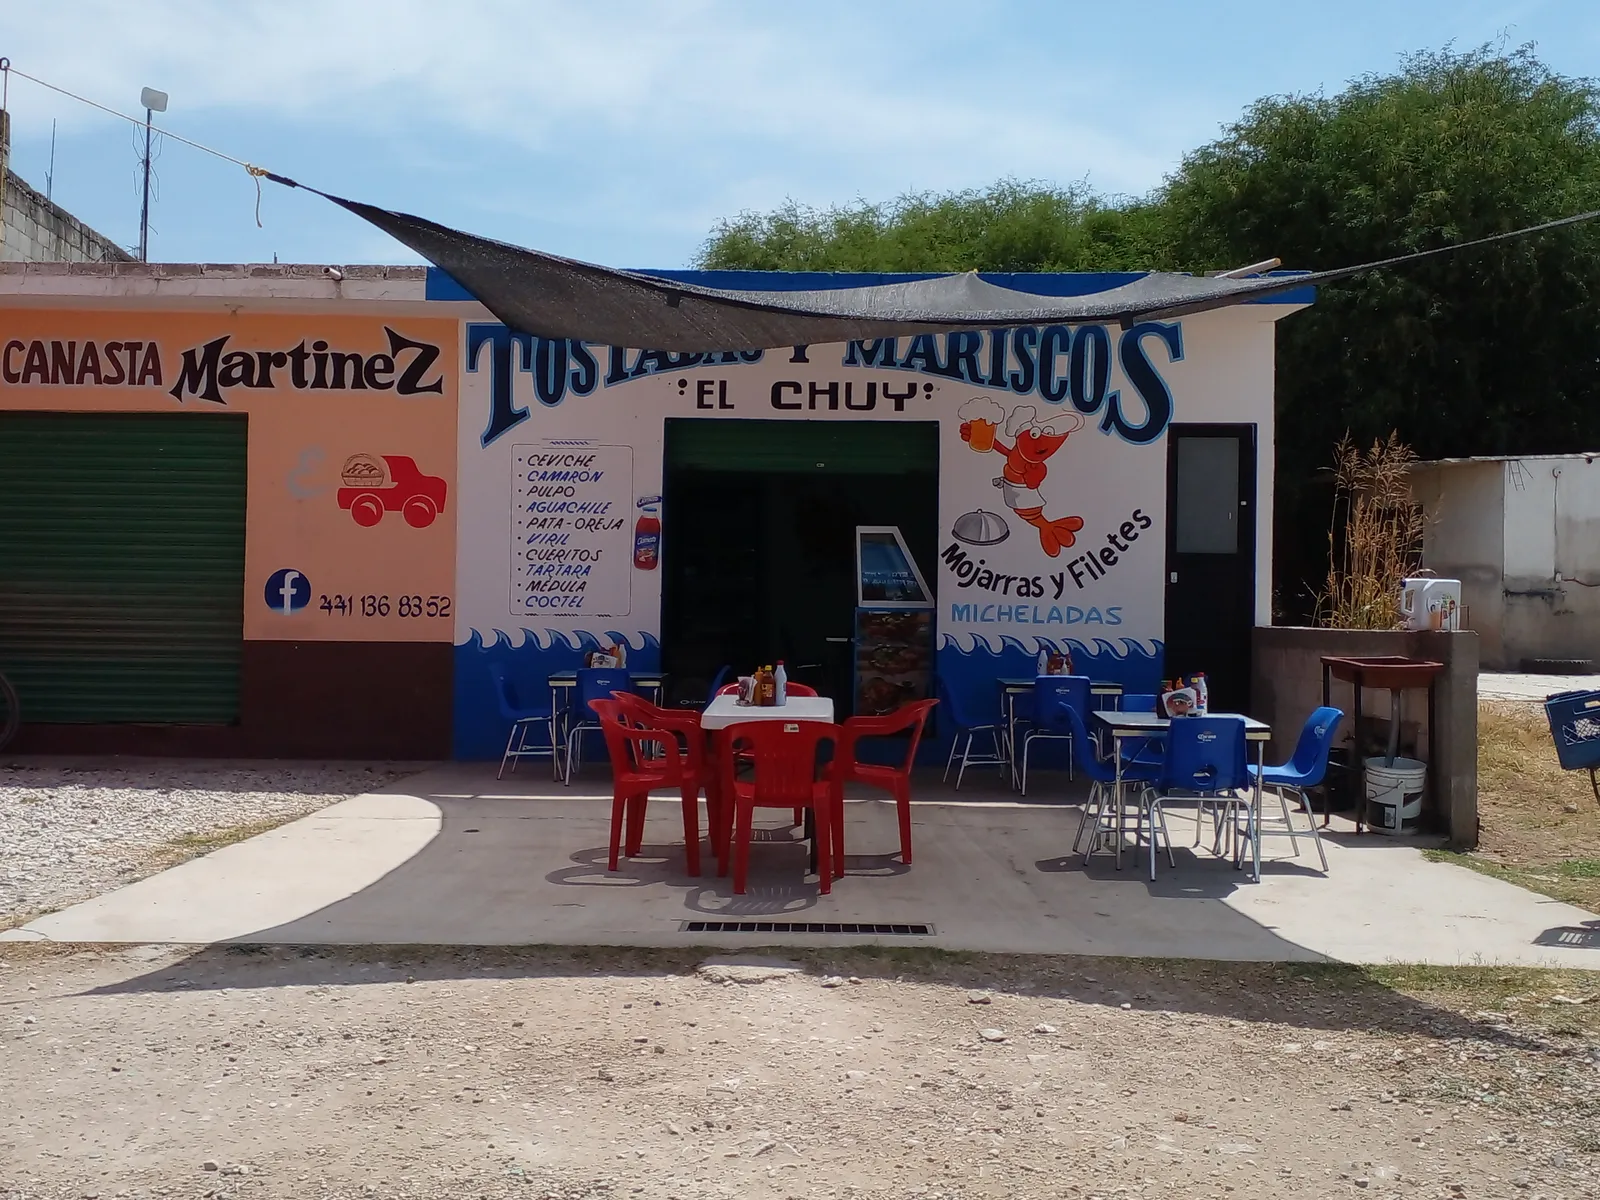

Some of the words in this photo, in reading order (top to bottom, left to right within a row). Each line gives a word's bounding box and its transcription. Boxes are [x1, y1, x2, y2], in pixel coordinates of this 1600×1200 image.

[2, 340, 163, 386] CANASTA
[466, 322, 765, 449] TOSTA
[842, 322, 1185, 445] MARISCOS
[697, 380, 735, 409] EL
[771, 381, 917, 411] CHUY
[527, 454, 596, 467] CEVICHE
[527, 468, 604, 484] CAMARÓN
[526, 485, 576, 497] PULPO
[526, 501, 612, 514] AGUACHILE
[526, 533, 570, 547] VIRIL
[526, 548, 602, 563] CUERITOS
[941, 543, 1045, 598] Mojarras
[1050, 571, 1066, 600] y
[1067, 508, 1152, 589] Filetes
[319, 594, 353, 616] 441
[360, 595, 391, 617] 136
[525, 595, 584, 608] COCTEL
[952, 603, 1123, 625] MICHELADAS
